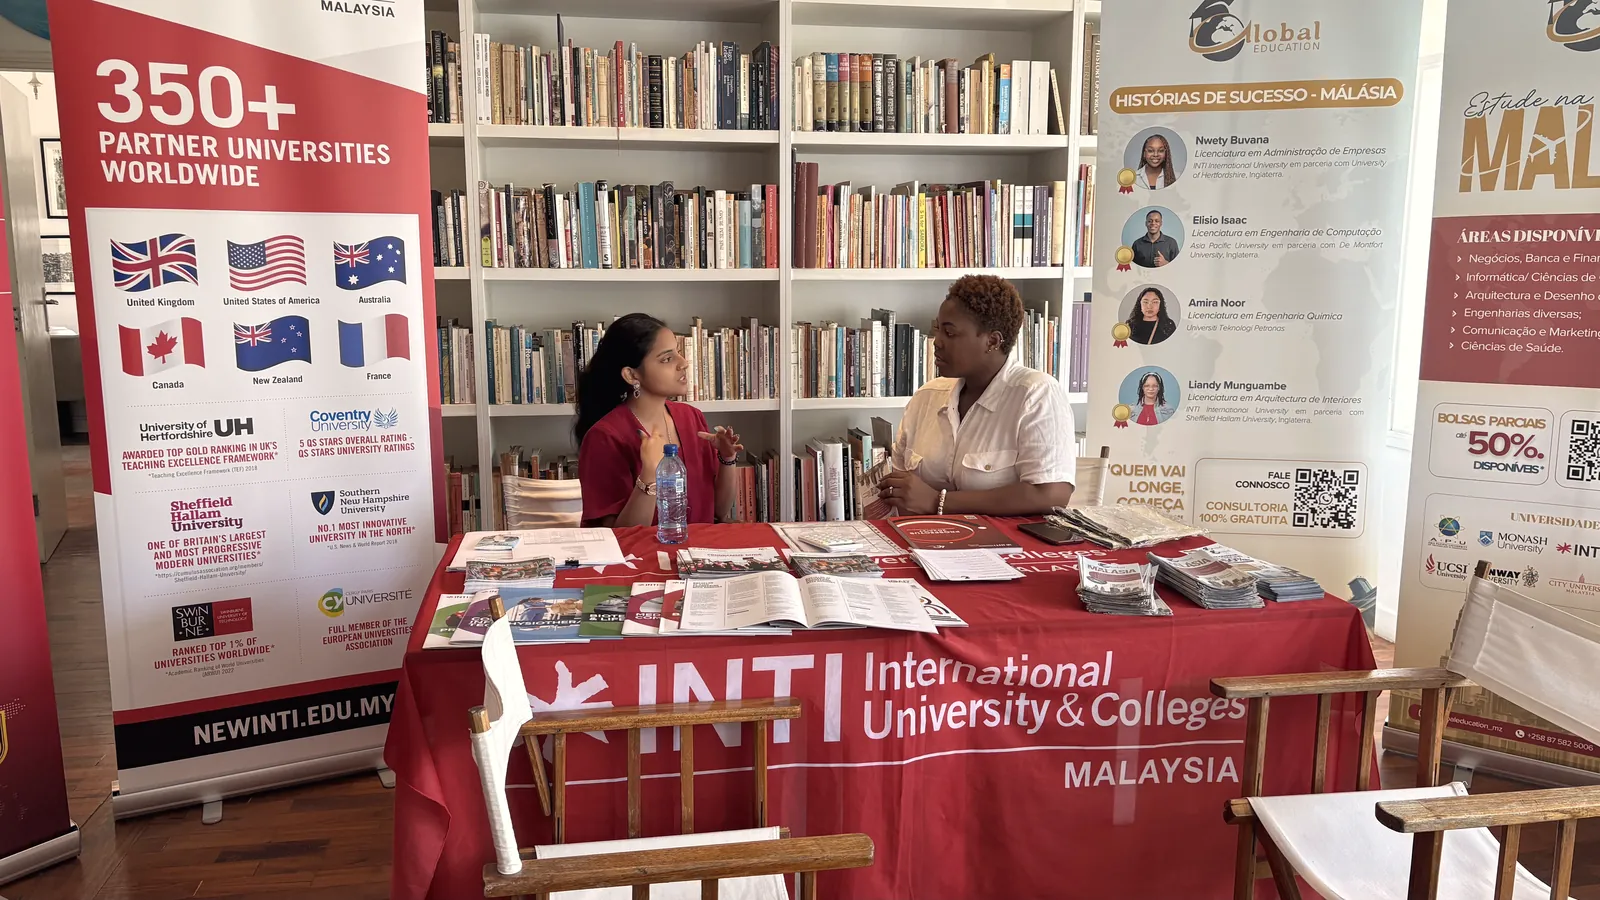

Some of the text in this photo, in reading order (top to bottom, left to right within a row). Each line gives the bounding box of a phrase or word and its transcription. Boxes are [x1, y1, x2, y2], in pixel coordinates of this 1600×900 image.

[321, 0, 395, 17] MALAYSIA
[1253, 42, 1320, 53] EDUCATION
[96, 59, 296, 130] 350+
[1116, 89, 1200, 107] HISTÓRIAS
[1204, 91, 1226, 104] DE
[1230, 88, 1308, 104] SUCESSO
[1464, 89, 1594, 118] Estude na
[1196, 136, 1269, 146] Nwety Buvana
[99, 131, 390, 164] PARTNER UNIVERSITIES
[1195, 150, 1246, 158] Licenciatura
[1264, 147, 1328, 156] Administração
[1329, 147, 1340, 155] de
[1342, 147, 1386, 156] Empresas
[101, 161, 259, 187] WORLDWIDE
[1193, 216, 1247, 224] Elisio Isaac
[1192, 229, 1242, 237] Licenciatura
[1260, 228, 1310, 238] Engenharia
[1326, 228, 1381, 237] Computação
[1457, 229, 1510, 244] ÁREAS
[1469, 254, 1522, 265] Negócios,
[1526, 254, 1560, 263] Banca
[1466, 272, 1596, 282] Informática/ Ciências de
[252, 297, 276, 305] States
[1465, 291, 1530, 301] Arquitectura
[1544, 291, 1595, 300] Desenho
[127, 298, 194, 308] United Kingdom
[1255, 312, 1304, 322] Engenharia
[1464, 308, 1582, 319] Engenharias diversas;
[1463, 326, 1536, 337] Comunicação
[1461, 341, 1563, 353] Ciências de Saúde.
[152, 381, 184, 389] Canada
[253, 375, 302, 384] New Zealand
[1189, 381, 1286, 392] Liandy Munguambe
[1188, 394, 1237, 402] Licenciatura
[1255, 394, 1306, 404] Arquitectura
[310, 410, 371, 422] Coventry
[1438, 413, 1546, 428] BOLSAS PARCIAIS
[140, 420, 207, 432] University of
[214, 418, 253, 437] UH
[311, 420, 372, 432] University
[140, 430, 213, 441] Hertfordshire
[123, 442, 277, 460] AWARDED TOP GOLD RANKING IN UK'S
[1468, 431, 1544, 459] 50%.
[122, 459, 165, 470] TEACHING
[169, 456, 221, 468] EXCELLENCE
[1161, 465, 1185, 477] VAI
[1268, 471, 1290, 480] FALE
[1129, 481, 1184, 495] LONGE,
[1235, 480, 1290, 489] CONNOSCO
[340, 489, 380, 497] Southern
[363, 494, 409, 504] Hampshire
[171, 497, 232, 511] Sheffield
[341, 505, 386, 514] University
[1206, 502, 1288, 513] CONSULTORIA
[171, 509, 221, 522] Hallam
[1199, 514, 1288, 524] 100% GRATUITA
[172, 518, 243, 532] University
[148, 531, 266, 550] ONE OF BRITAIN'S LARGEST
[1498, 533, 1548, 545] MONASH
[154, 541, 262, 560] AND MOST PROGRESSIVE
[1498, 541, 1543, 554] University
[156, 559, 193, 570] MODERN
[1437, 562, 1468, 574] UCSI
[1437, 571, 1467, 580] University
[346, 588, 412, 605] UNIVERSITÉ
[172, 637, 257, 656] RANKED TOP 1% OF
[155, 654, 215, 669] UNIVERSITIES
[864, 651, 1113, 692] International
[639, 653, 843, 754] INTI
[194, 694, 396, 745] NEWINTI.EDU.MY
[864, 690, 1246, 740] University & Colleges
[1064, 756, 1239, 788] MALAYSIA
